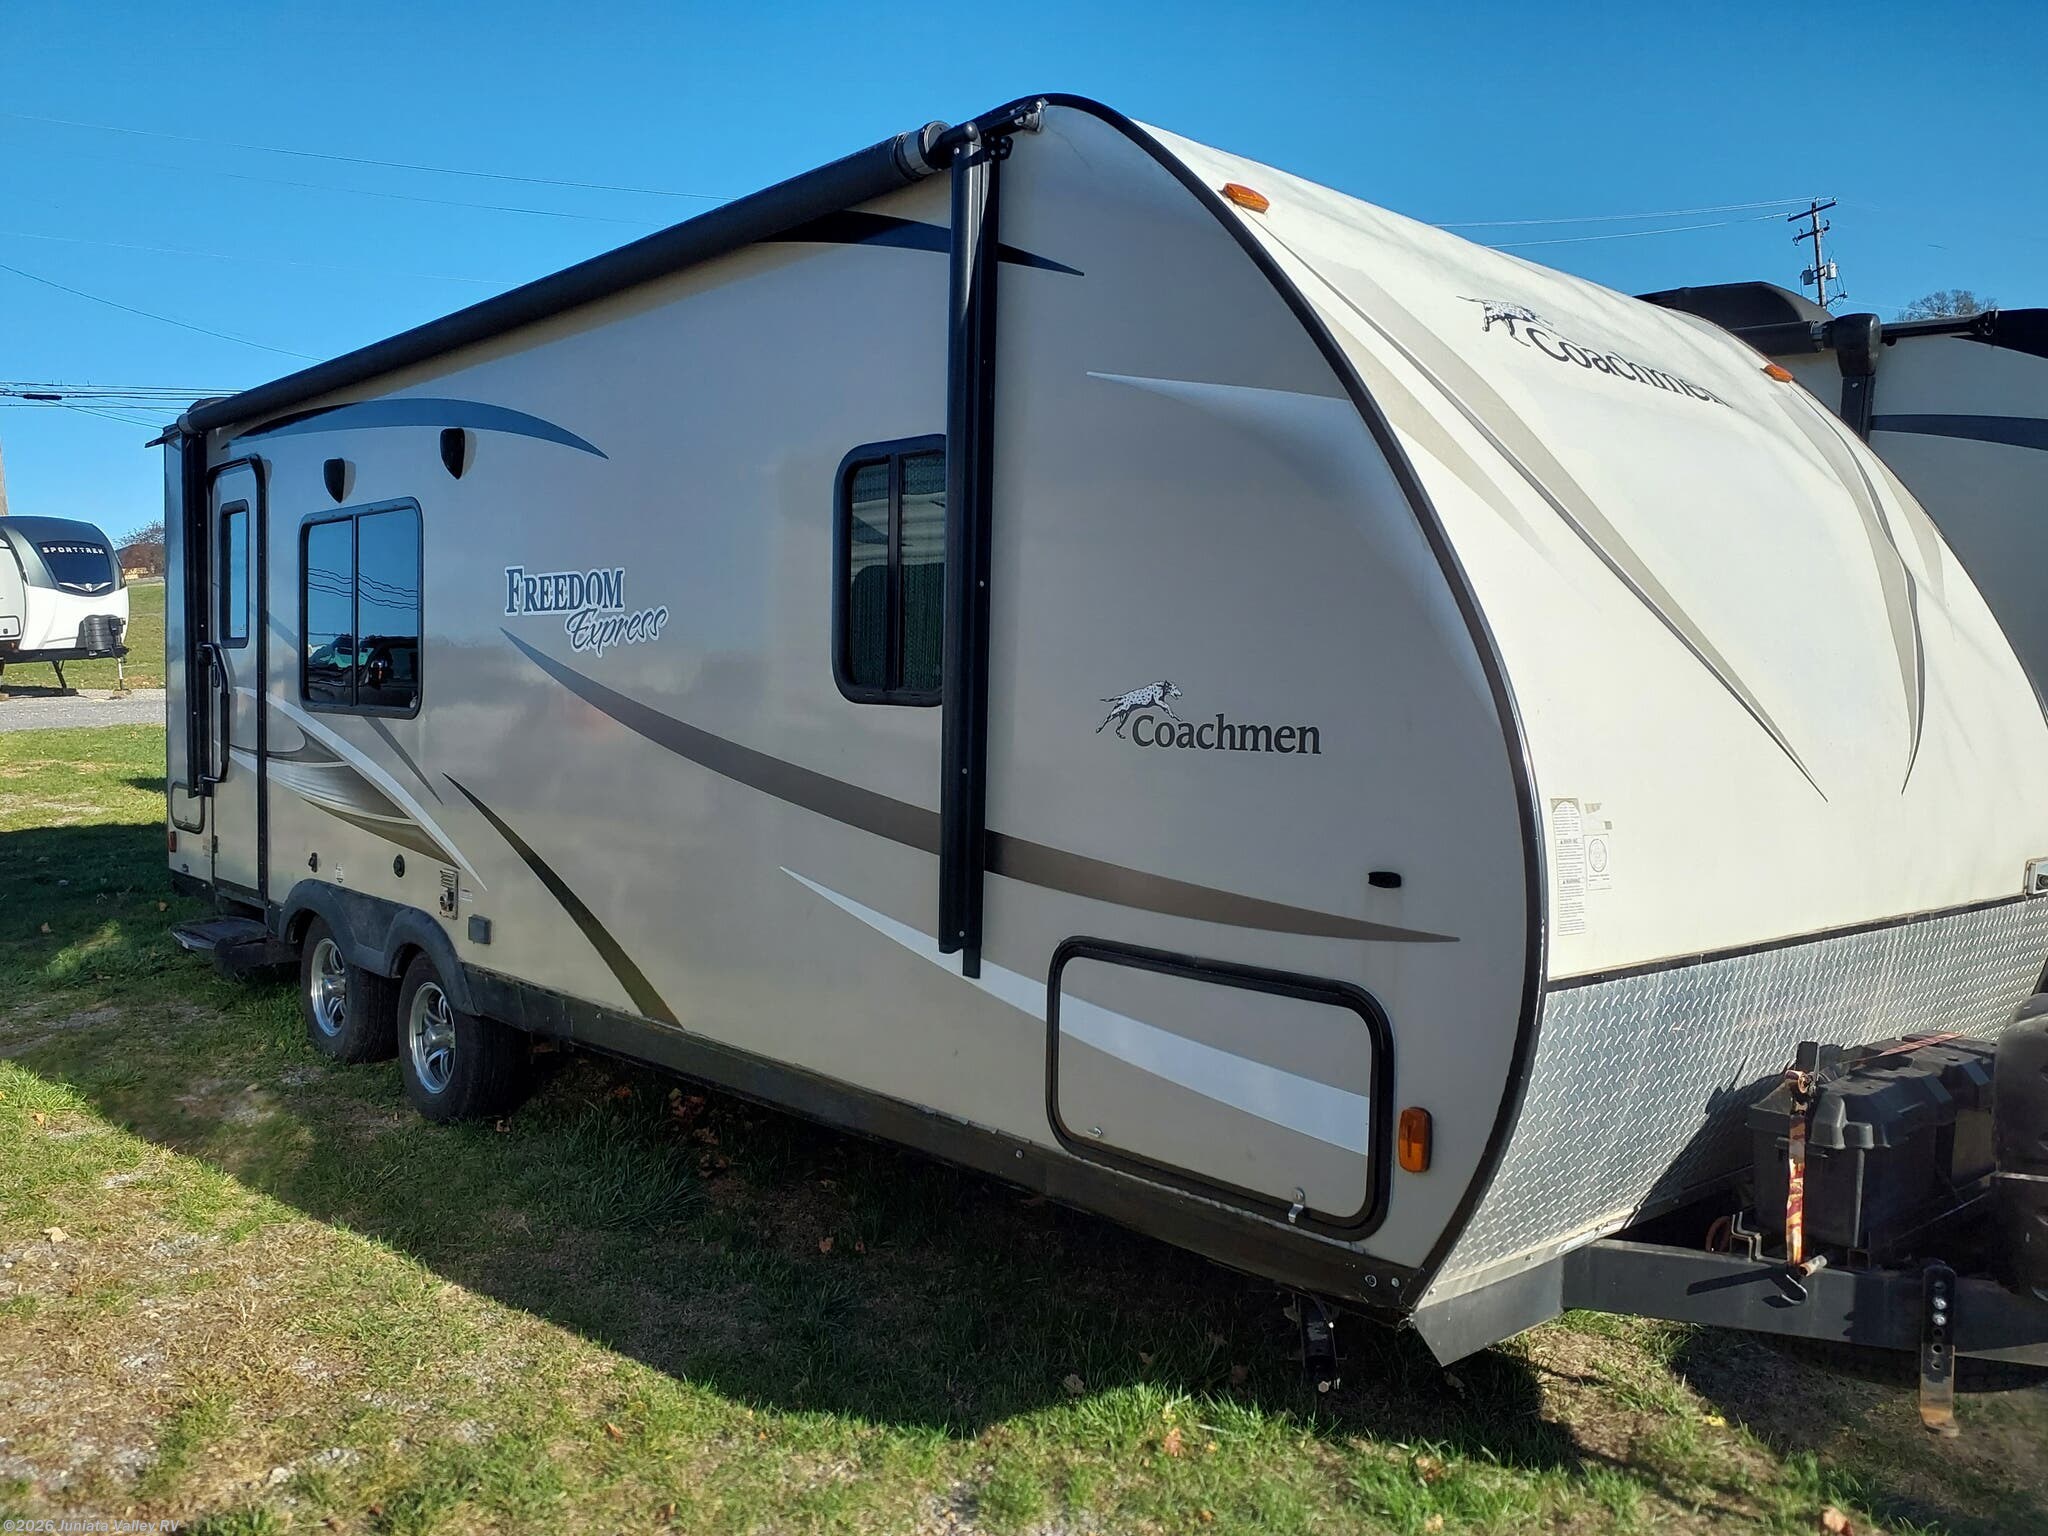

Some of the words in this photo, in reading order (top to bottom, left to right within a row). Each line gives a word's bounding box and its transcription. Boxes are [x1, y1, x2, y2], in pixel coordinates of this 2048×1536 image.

[505, 566, 624, 615] FREEDOM
[564, 605, 668, 657] Express
[1132, 713, 1322, 755] Coachmen
